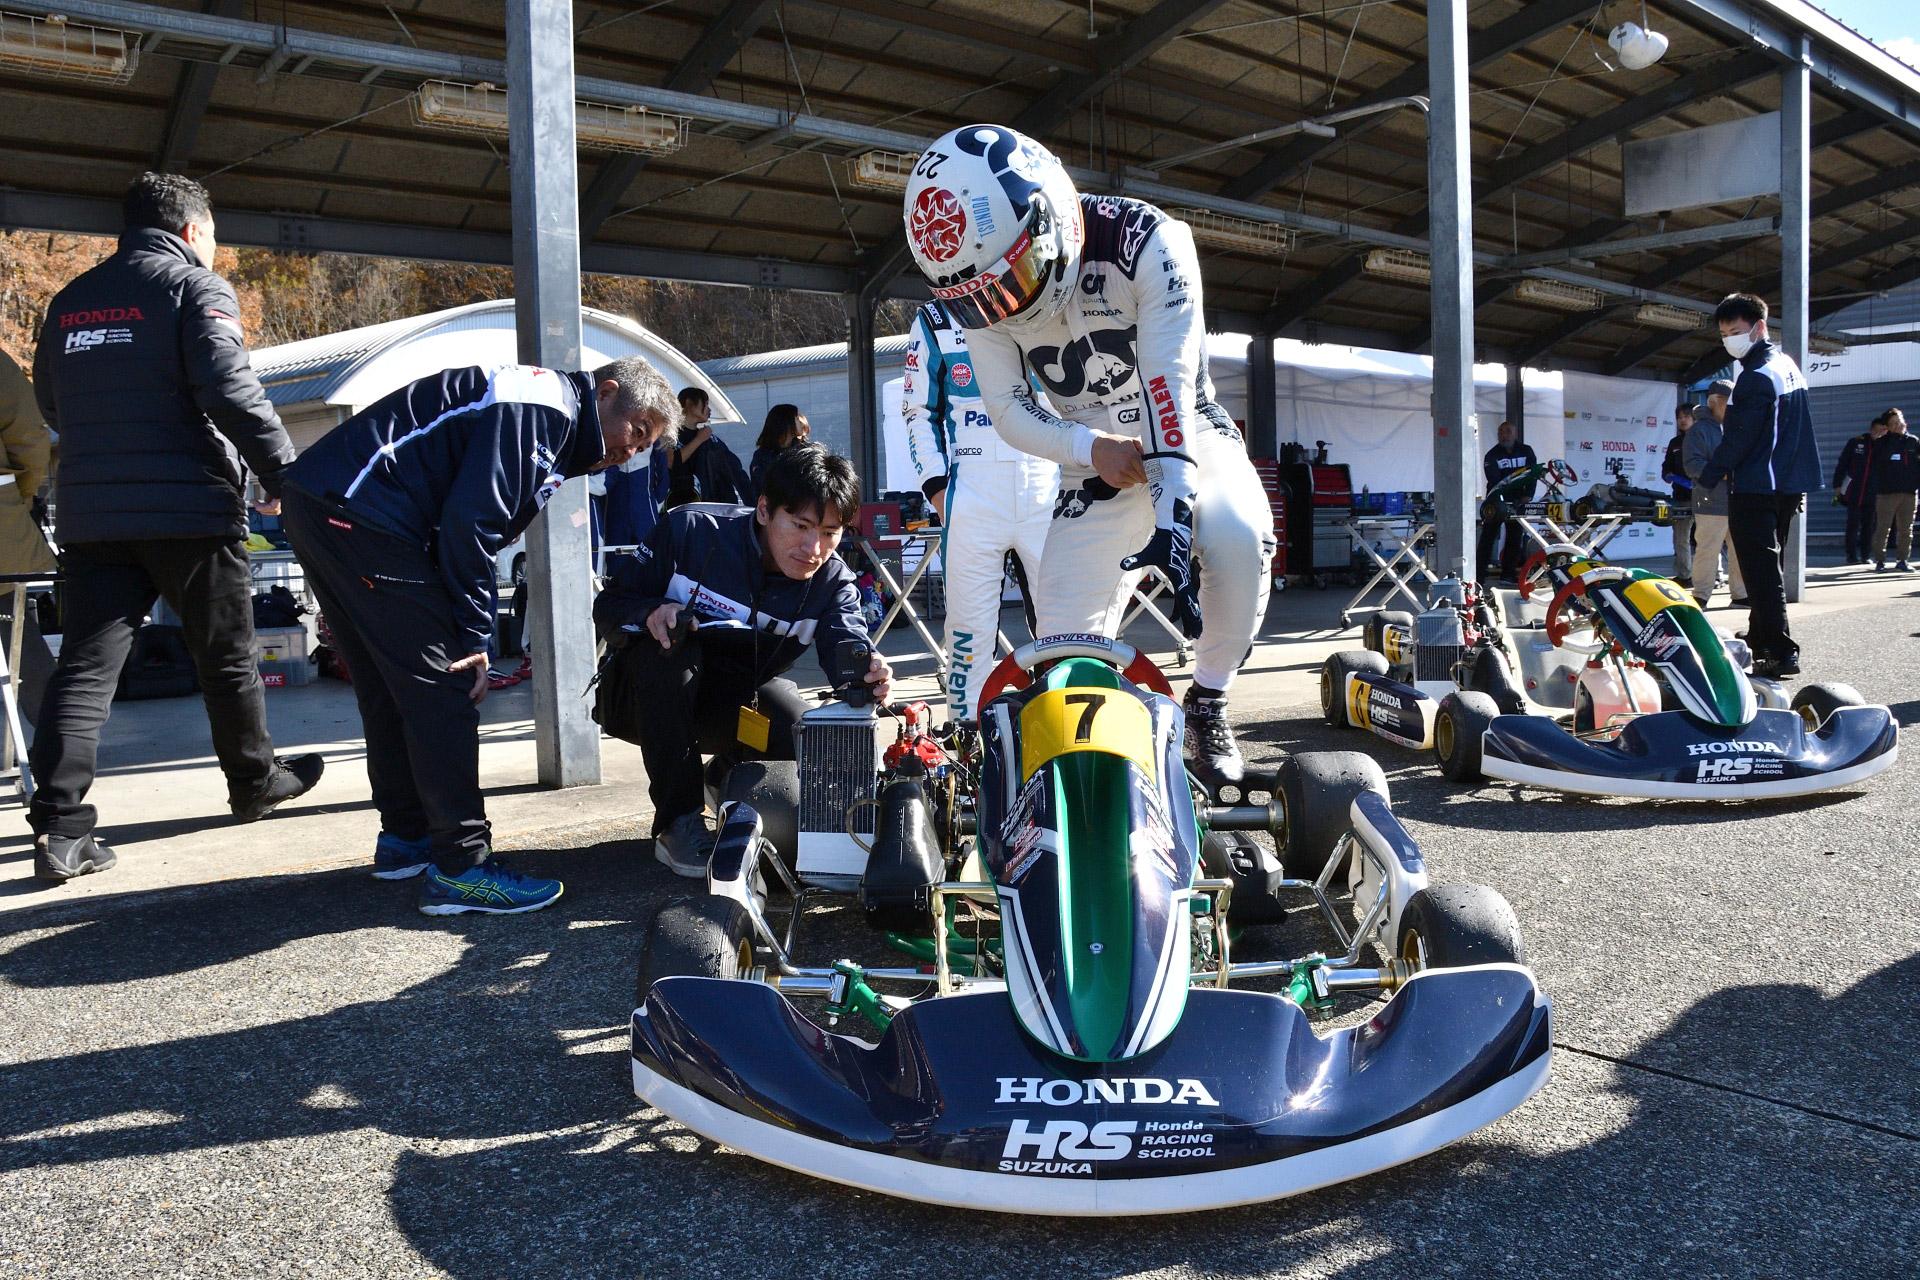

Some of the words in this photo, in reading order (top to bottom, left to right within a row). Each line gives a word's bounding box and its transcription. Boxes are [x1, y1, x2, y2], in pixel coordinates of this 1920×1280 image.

[916, 151, 949, 180] 22
[971, 195, 998, 238] TSUNODA
[1014, 237, 1030, 255] ORLEN
[931, 271, 999, 300] HONDA
[59, 307, 145, 328] HONDA
[1081, 308, 1123, 317] HONDA
[65, 328, 108, 348] HRS
[1148, 375, 1184, 448] ORLEN
[954, 447, 983, 457] sparco
[1601, 440, 1637, 452] HONDA
[1654, 582, 1685, 602] 6
[949, 630, 973, 722] Niterr
[1355, 682, 1366, 727] 6
[1370, 689, 1402, 710] HONDA
[1065, 694, 1106, 744] 7
[1370, 704, 1389, 723] HRS
[1686, 741, 1784, 756] HONDA
[1697, 757, 1754, 778] HRS
[1696, 776, 1737, 784] SUZUKA
[994, 1077, 1220, 1107] HONDA
[1144, 1120, 1204, 1132] Honda
[1001, 1118, 1138, 1161] HRS
[1141, 1133, 1214, 1146] RACING
[1137, 1146, 1216, 1159] SCHOOL
[998, 1160, 1093, 1174] SUZUKA
